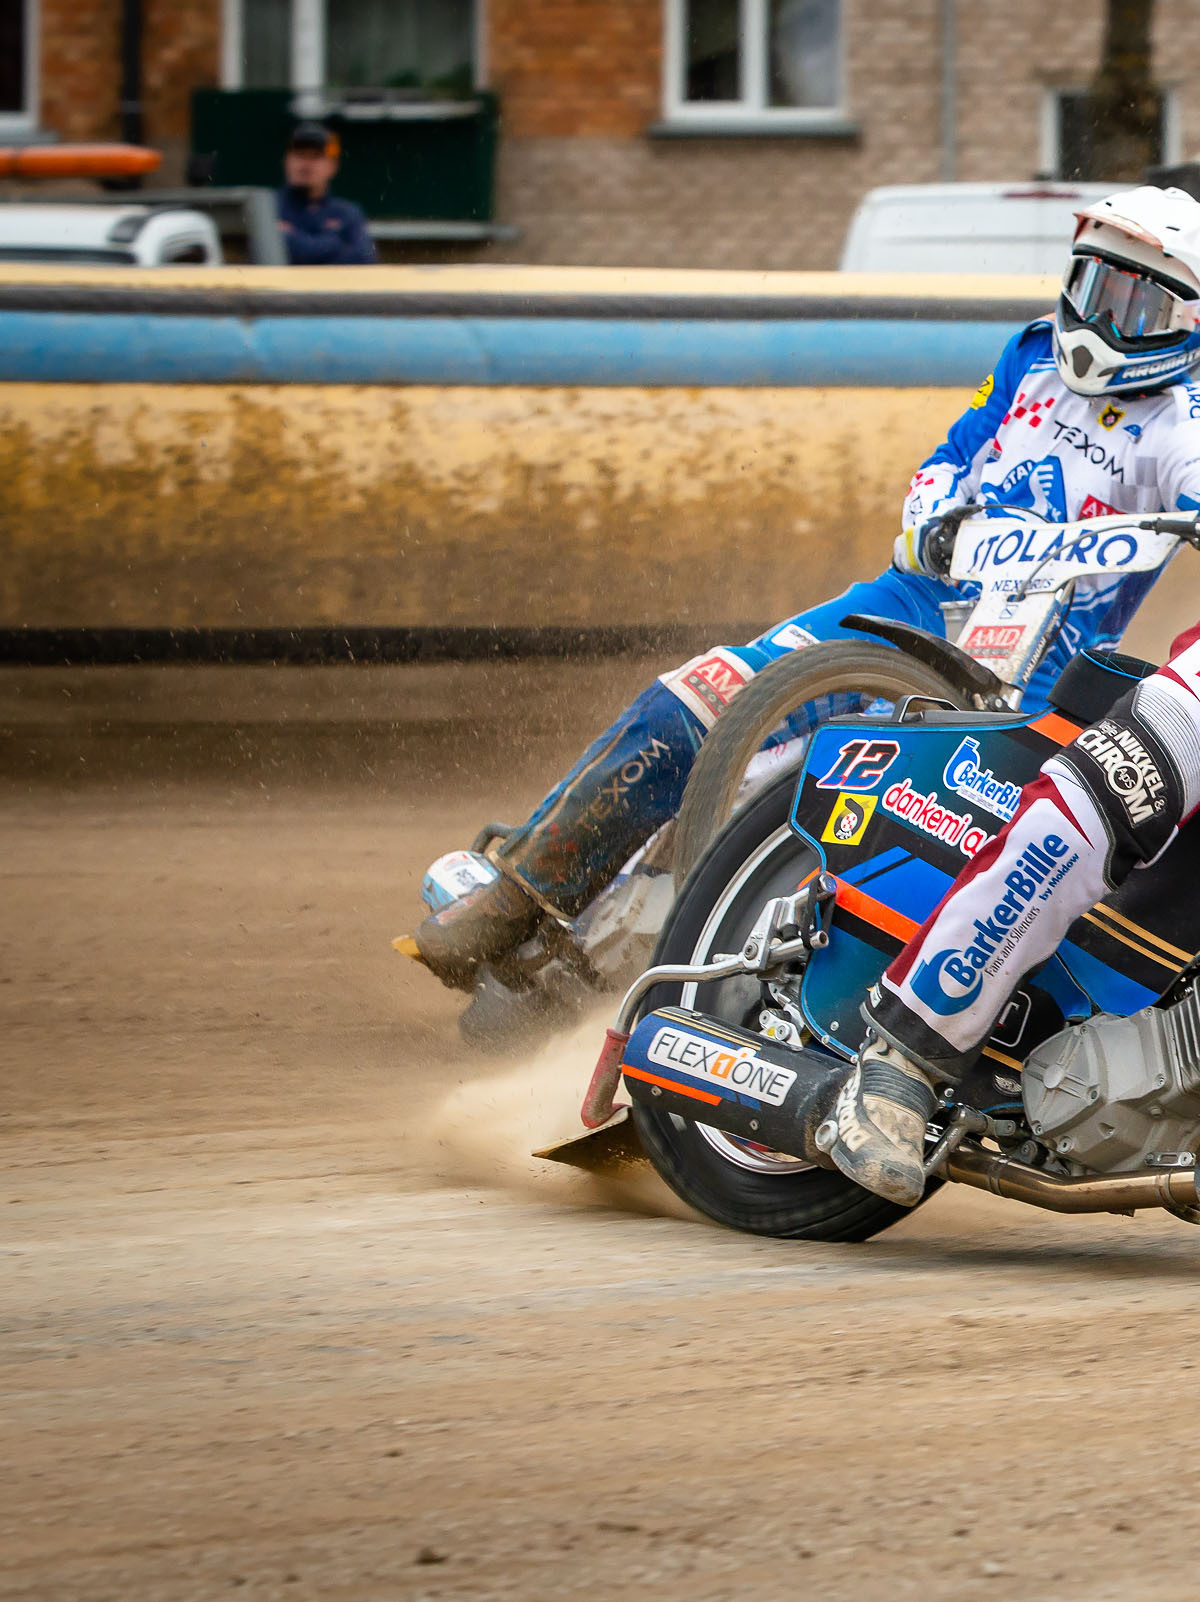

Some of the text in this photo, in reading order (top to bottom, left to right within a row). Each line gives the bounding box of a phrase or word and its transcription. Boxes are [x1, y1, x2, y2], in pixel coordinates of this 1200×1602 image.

[1054, 420, 1124, 484] TEXOM
[968, 529, 1138, 574] STOLARO
[967, 628, 1022, 647] AMD
[696, 661, 746, 702] AM
[816, 739, 900, 790] 12
[1076, 729, 1155, 824] CHROM
[1114, 729, 1165, 811] NIKKEL &
[884, 781, 968, 844] dankemi
[963, 829, 984, 854] a
[1038, 852, 1080, 902] by Moldow
[944, 834, 1070, 988] BarkerBille
[984, 905, 1041, 978] Fans and Silencers
